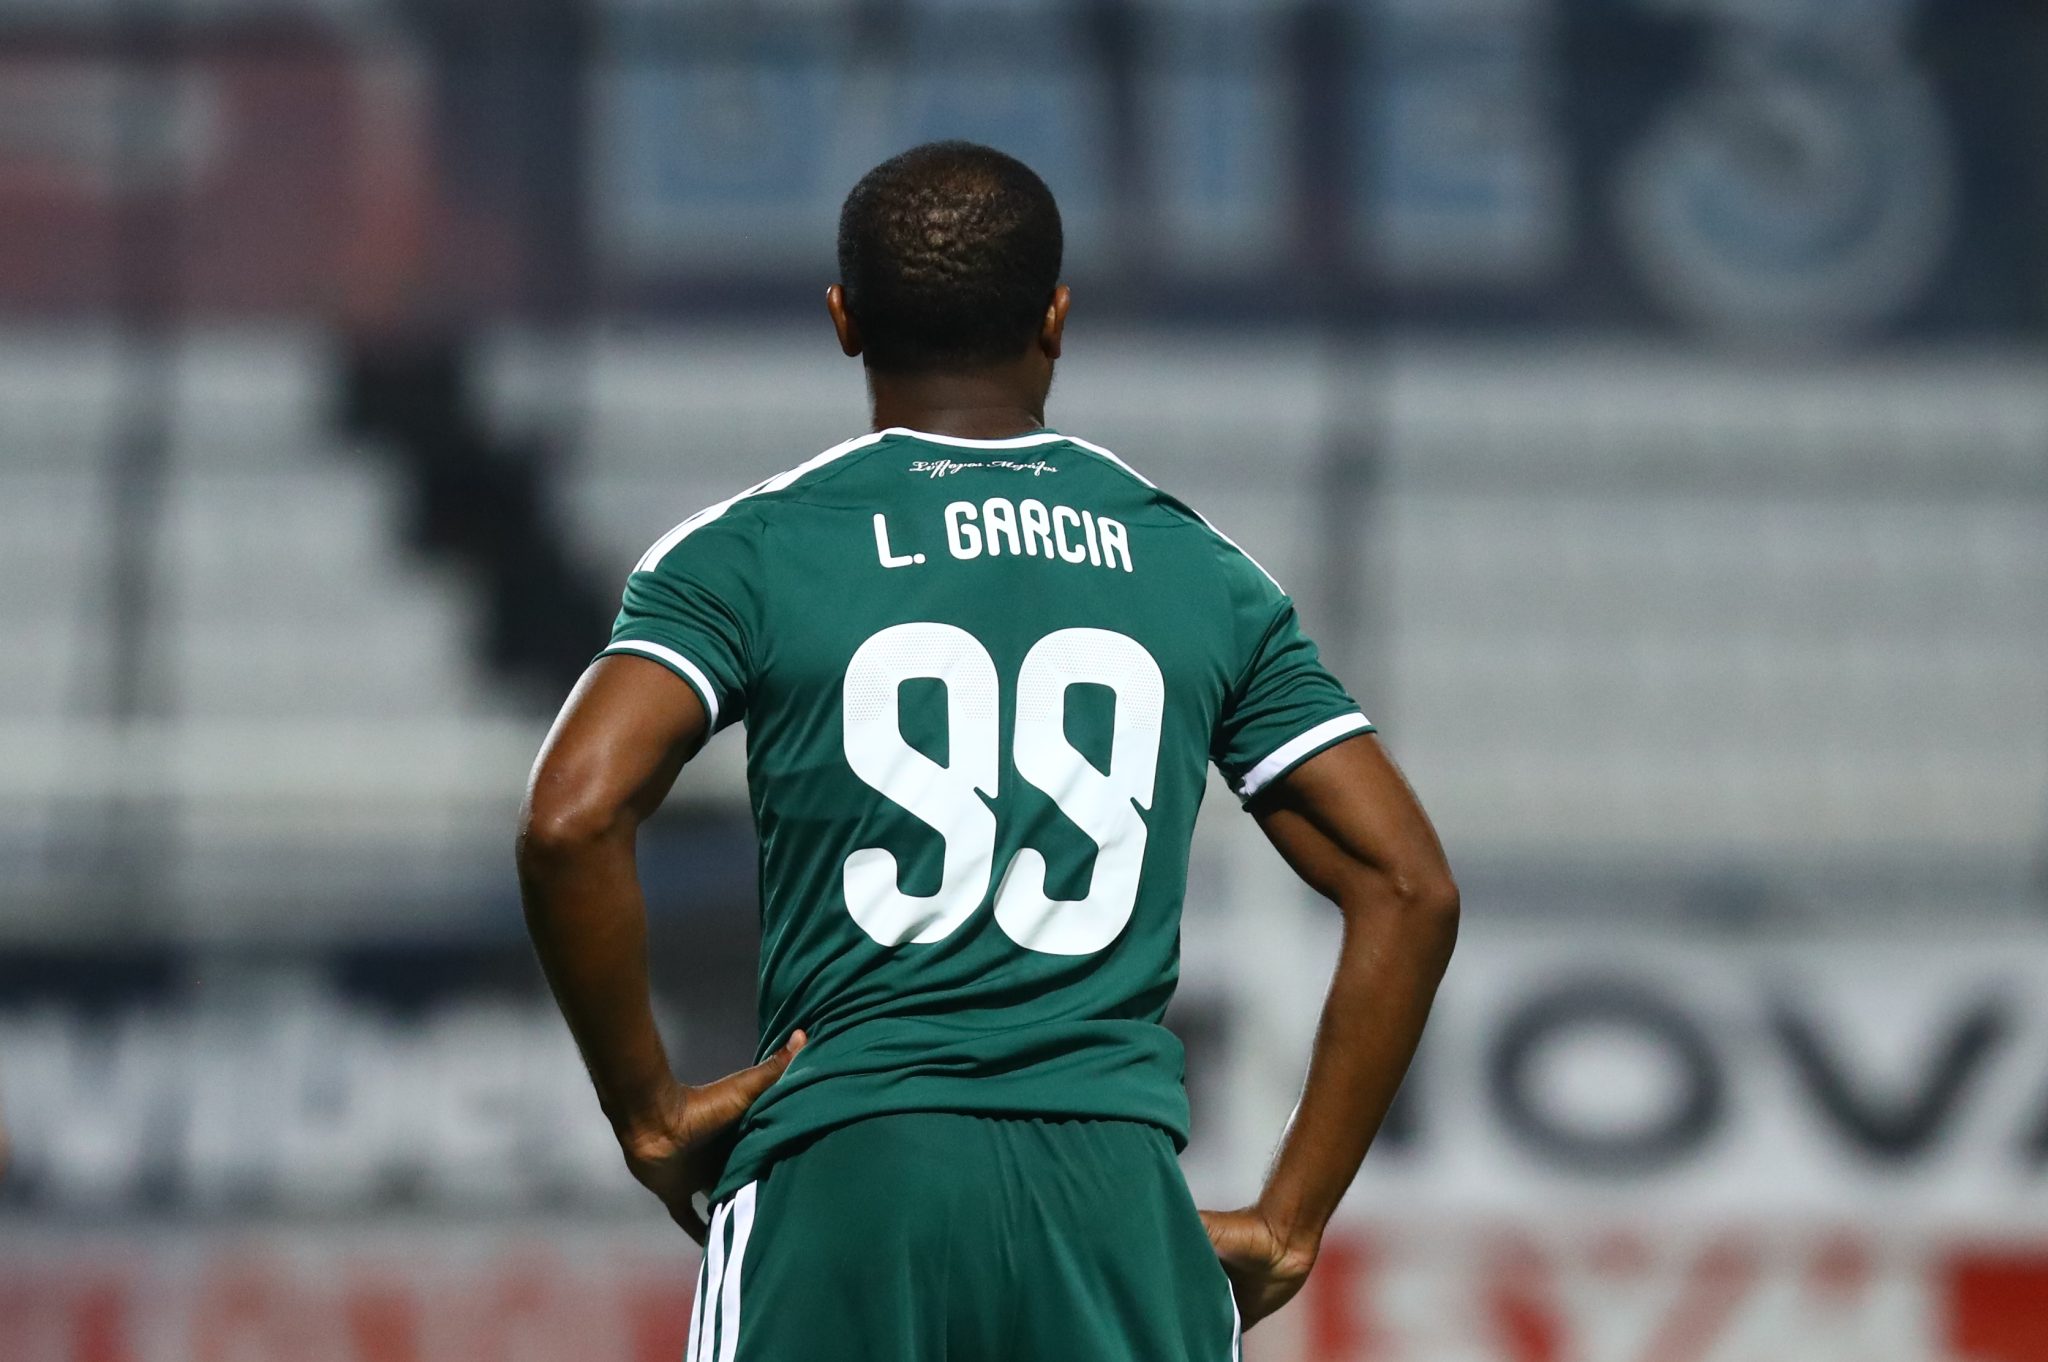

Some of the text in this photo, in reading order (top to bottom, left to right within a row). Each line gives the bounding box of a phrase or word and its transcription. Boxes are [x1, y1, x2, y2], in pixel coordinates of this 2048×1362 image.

[873, 497, 1134, 573] L. GARCIA
[842, 621, 1165, 956] 99
